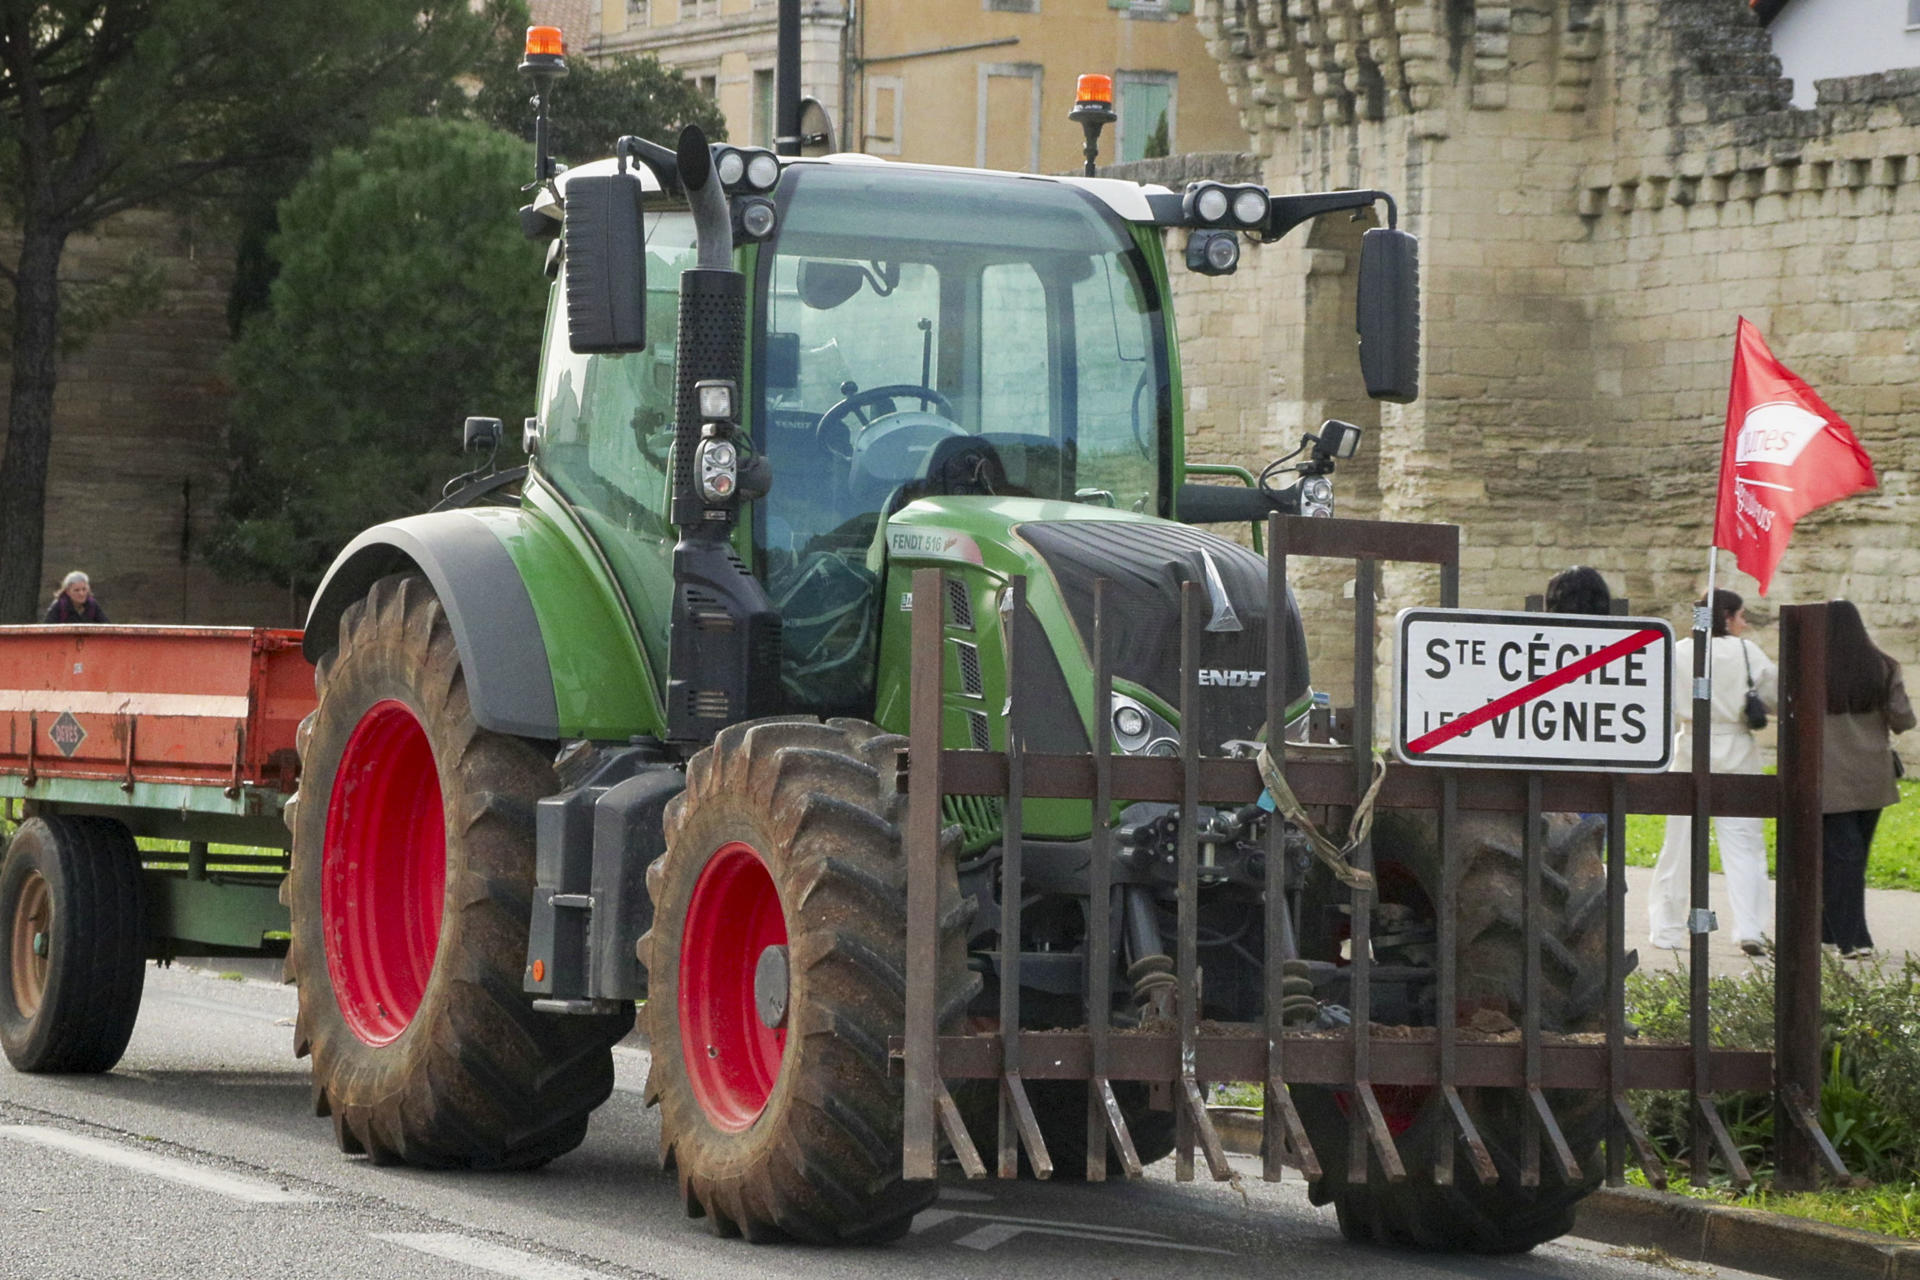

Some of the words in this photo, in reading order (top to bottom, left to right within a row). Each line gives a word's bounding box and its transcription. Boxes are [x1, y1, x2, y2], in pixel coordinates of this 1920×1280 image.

[893, 534, 923, 550] FENDT
[1498, 633, 1647, 687] CÉCILE
[1198, 669, 1266, 687] ENDT
[1487, 698, 1646, 744] VIGNES
